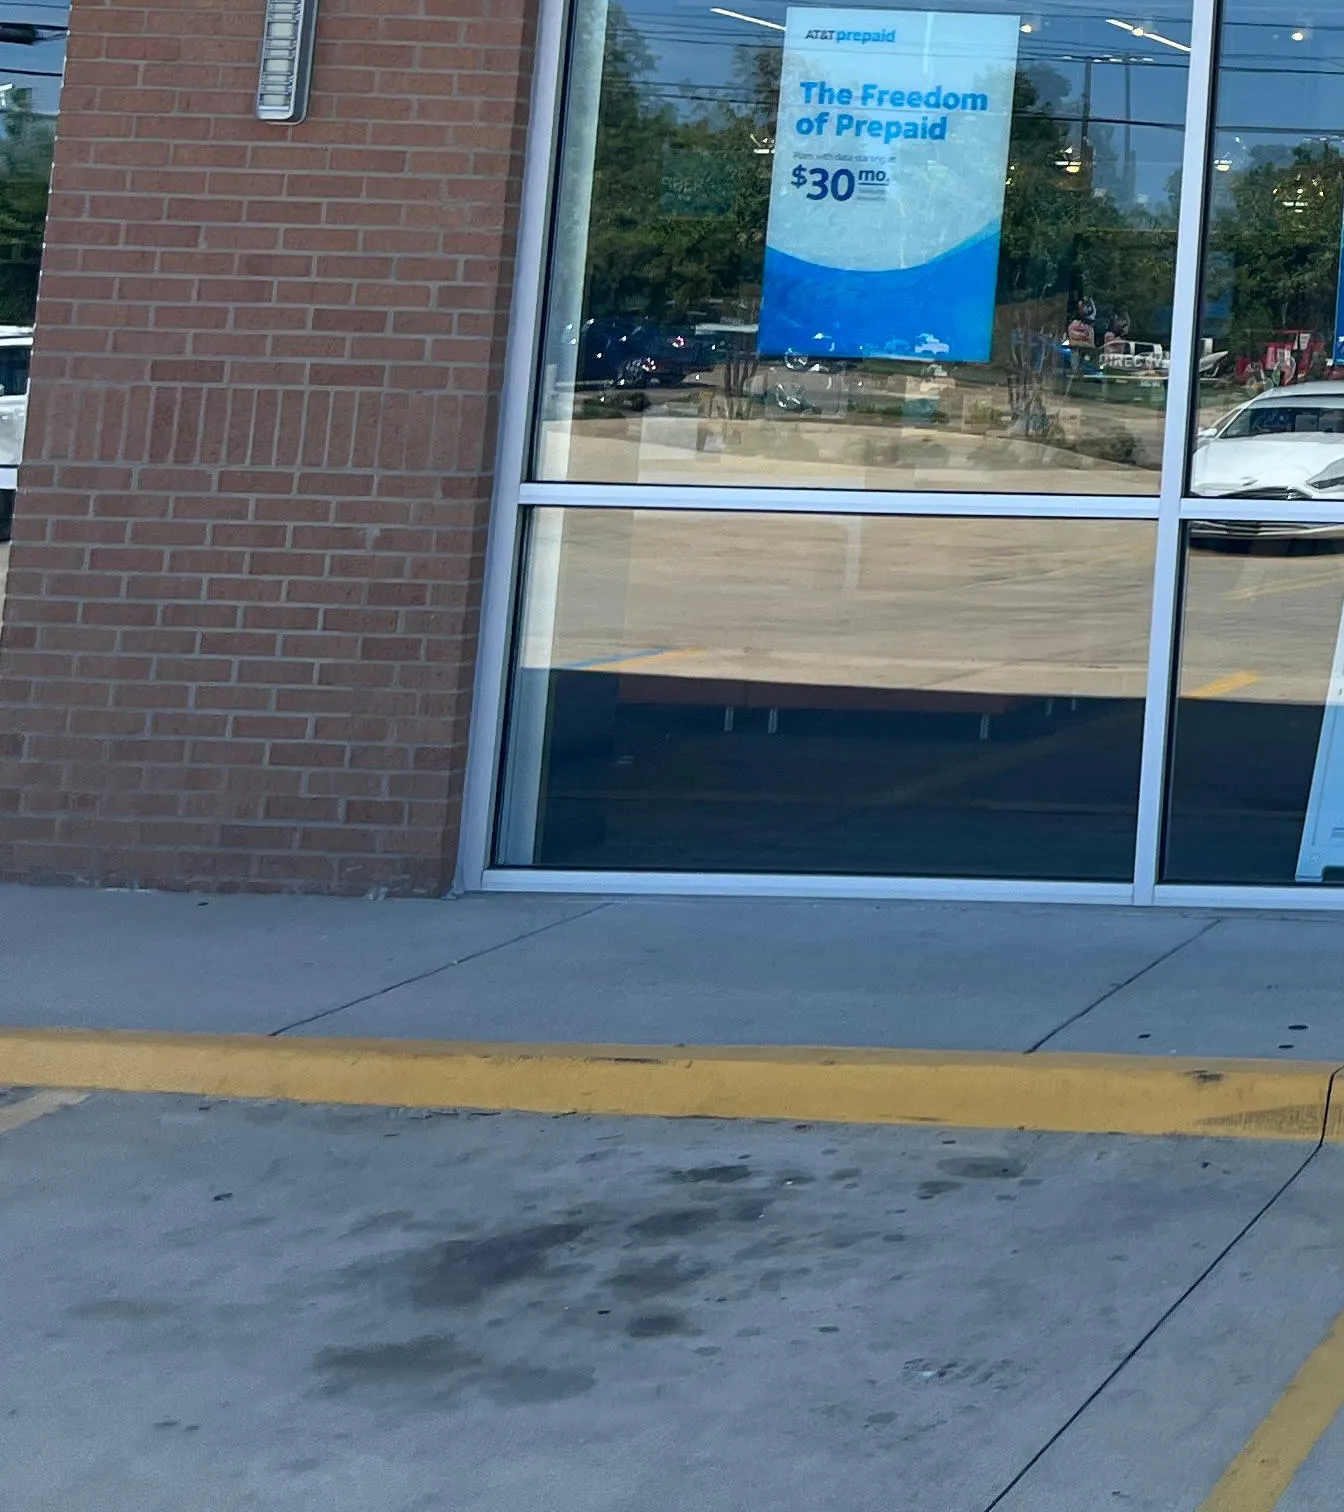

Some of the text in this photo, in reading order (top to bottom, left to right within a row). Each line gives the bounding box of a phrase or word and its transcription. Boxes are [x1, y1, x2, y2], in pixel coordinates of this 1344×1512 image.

[836, 28, 896, 44] prepaid
[800, 81, 988, 111] The Freedom
[796, 112, 948, 144] of Prepaid
[791, 164, 856, 201] $30
[858, 169, 890, 183] mo.
